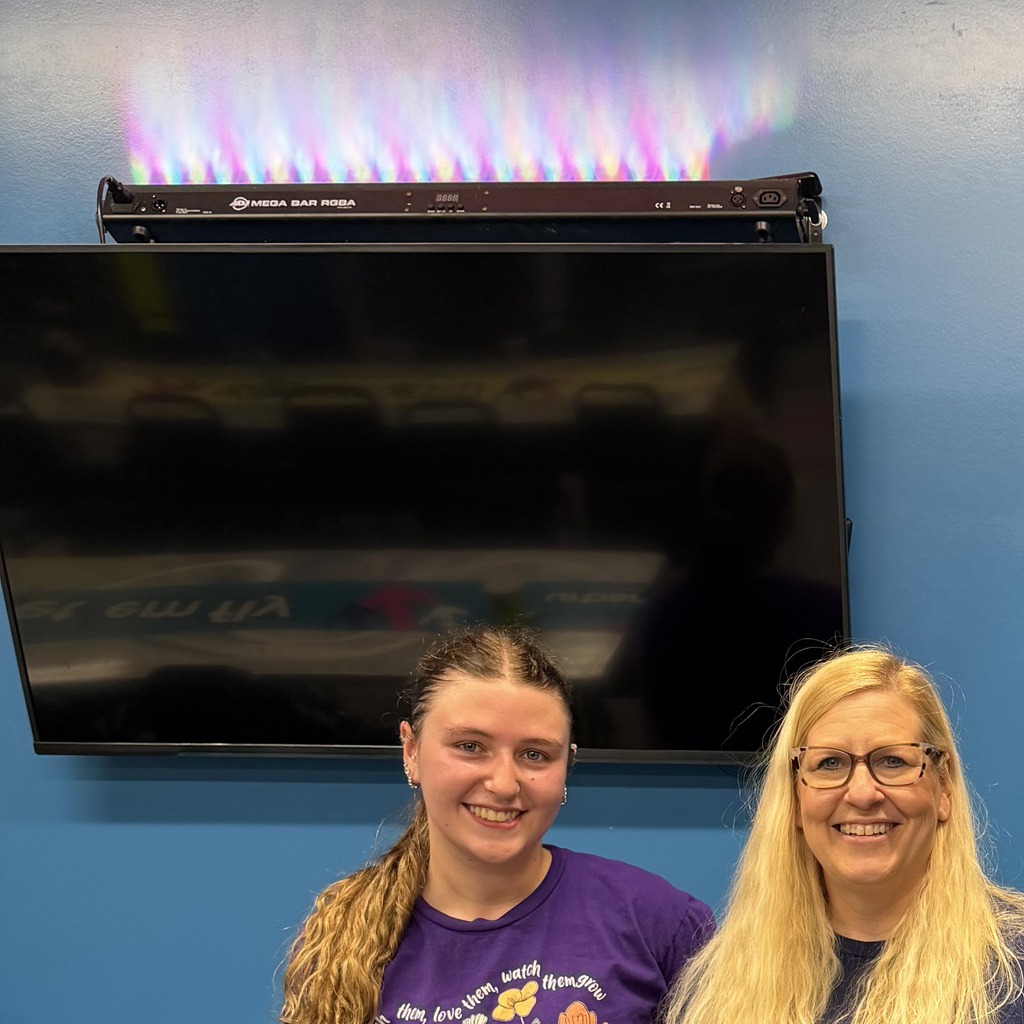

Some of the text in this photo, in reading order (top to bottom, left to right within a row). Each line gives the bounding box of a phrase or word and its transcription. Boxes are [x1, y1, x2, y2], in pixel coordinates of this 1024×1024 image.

[251, 199, 287, 207] MEGA
[291, 199, 317, 207] BAR
[321, 199, 356, 207] RGBA
[397, 1003, 427, 1024] them,
[433, 1005, 463, 1023] love
[462, 981, 499, 1010] them,
[501, 960, 541, 983] watch
